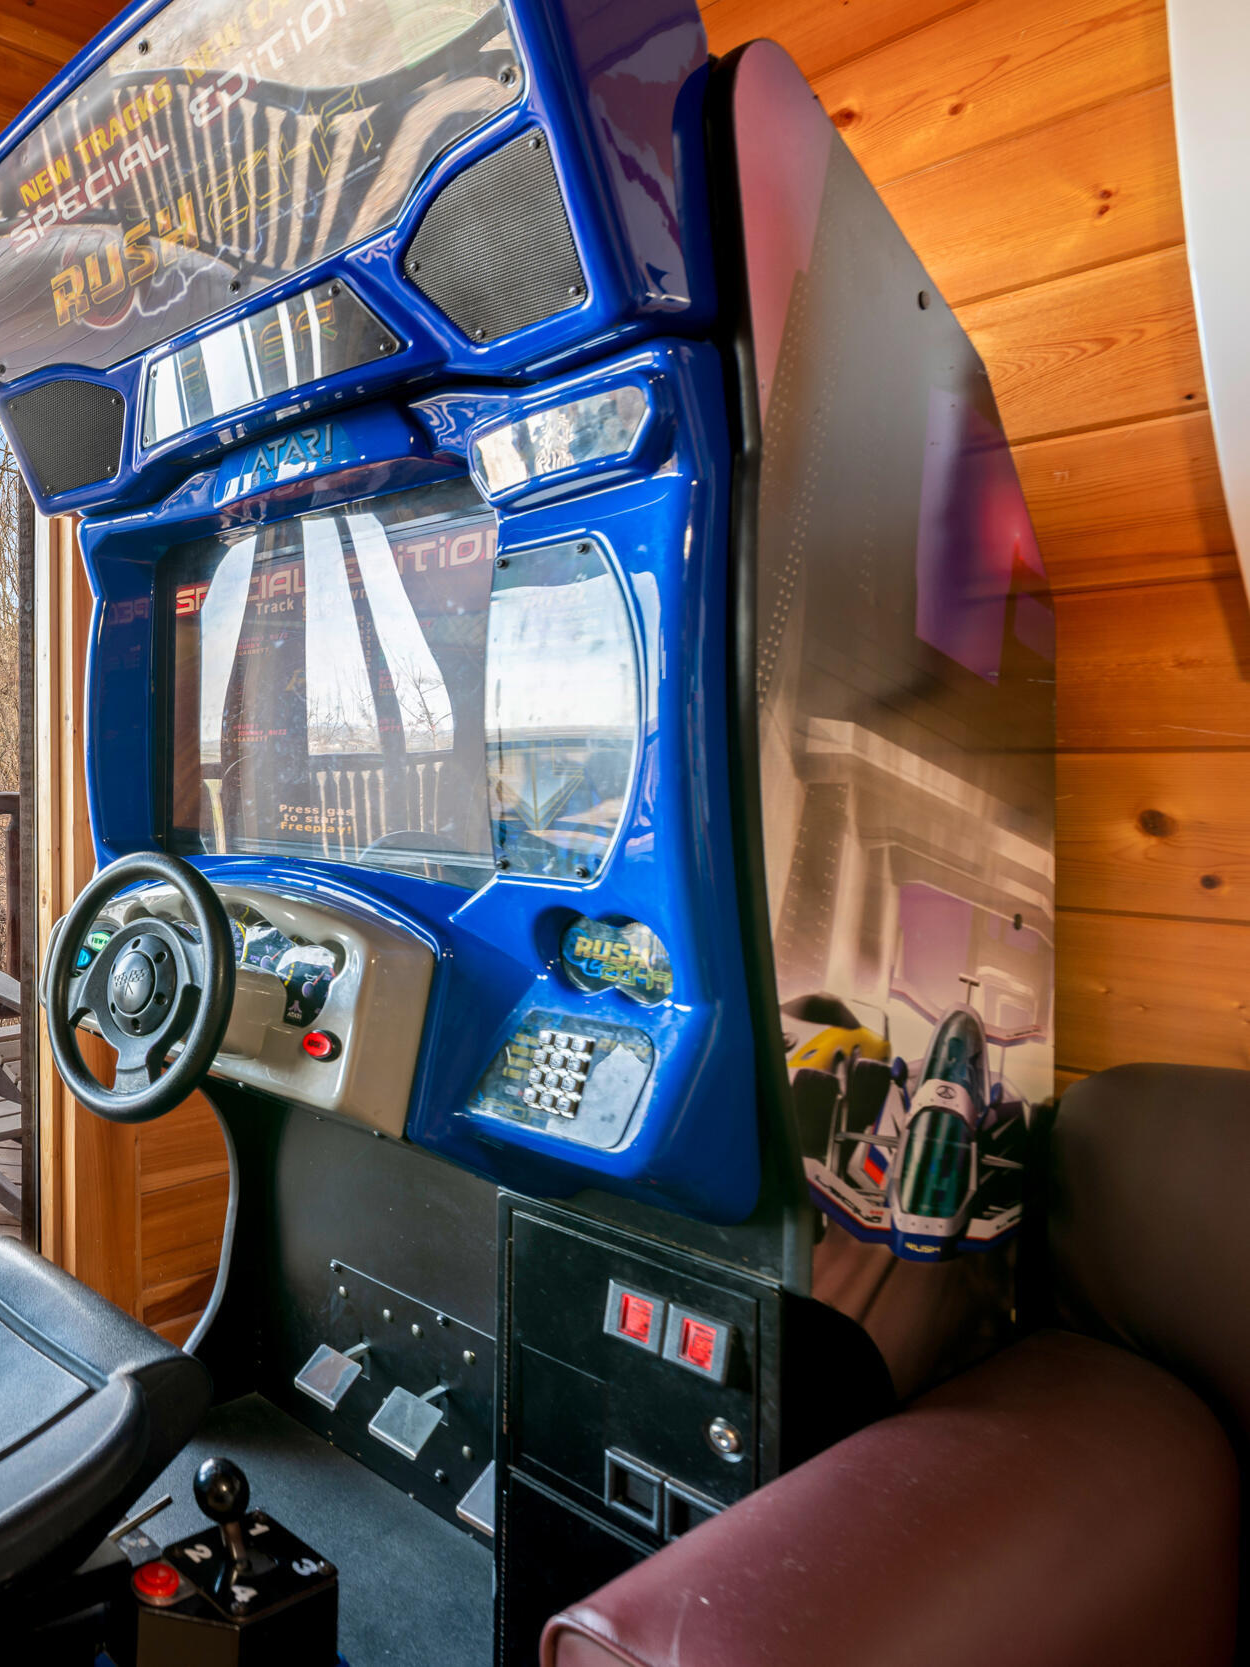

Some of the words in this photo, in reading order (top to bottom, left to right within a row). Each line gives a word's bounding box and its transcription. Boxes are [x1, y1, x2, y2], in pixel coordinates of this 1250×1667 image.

[19, 154, 71, 208] NEW
[74, 76, 173, 165] TRACKS
[182, 16, 242, 86] NEW
[10, 134, 170, 253] SPECIAL
[50, 191, 200, 327] RUSH
[205, 85, 375, 231] 2049
[252, 423, 333, 474] ATARI
[255, 599, 294, 615] Track
[279, 803, 320, 815] Press
[326, 807, 355, 817] gas
[283, 813, 298, 822] to
[280, 821, 352, 836] Freeplay!
[574, 936, 651, 969] RUSH
[248, 1522, 270, 1537] 1
[184, 1543, 213, 1564] 2
[291, 1557, 319, 1577] 3
[230, 1585, 258, 1603] 4
